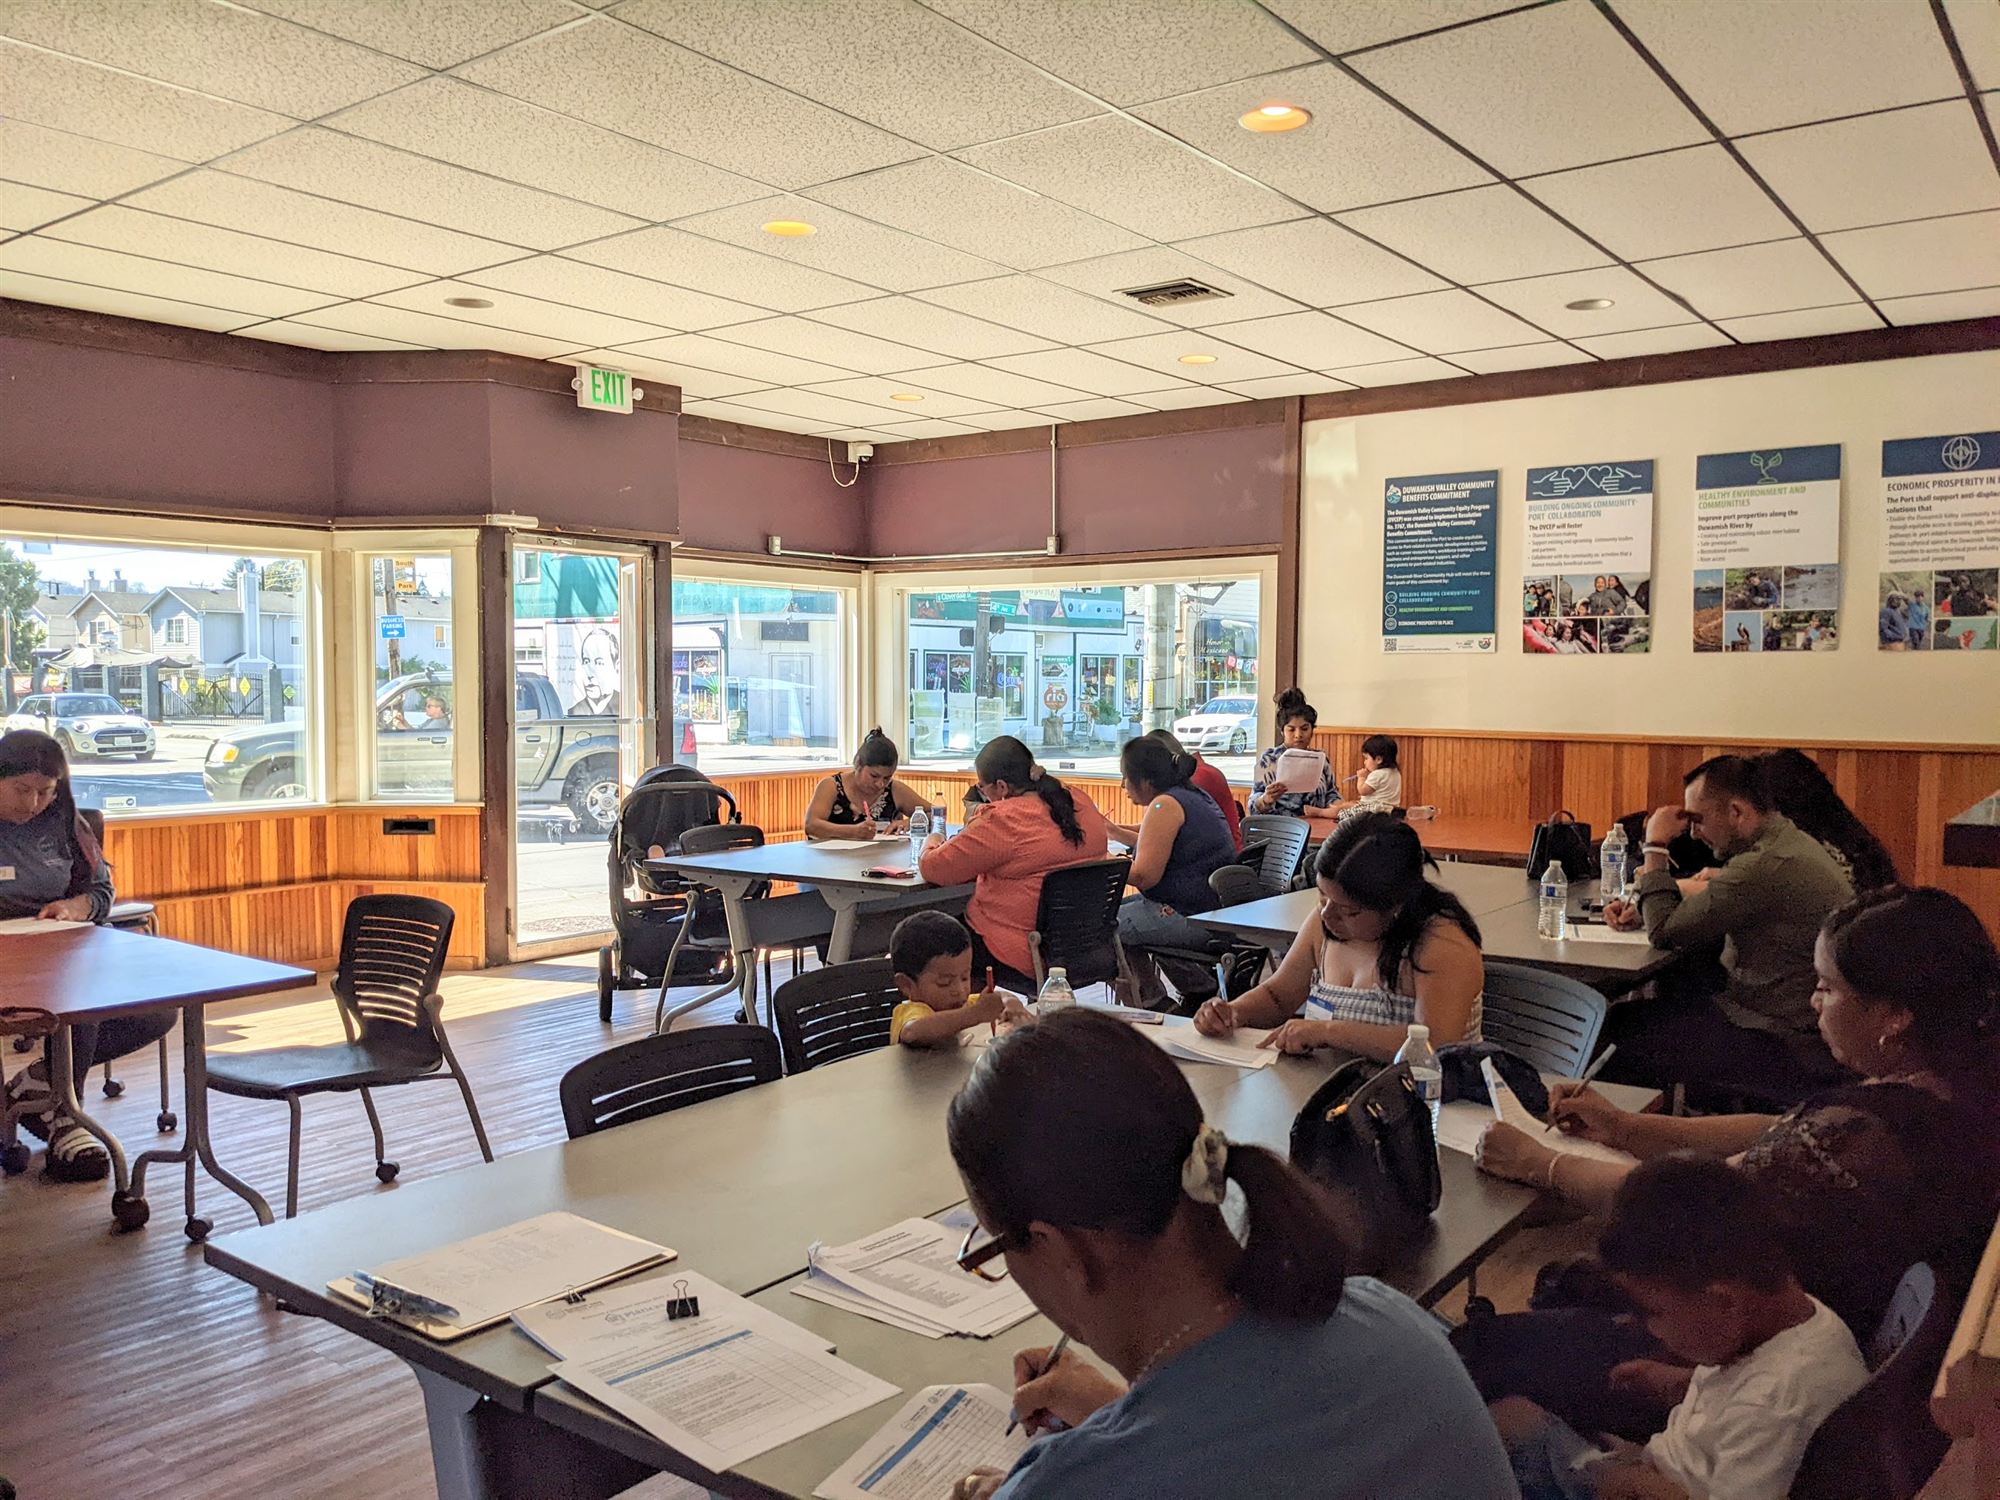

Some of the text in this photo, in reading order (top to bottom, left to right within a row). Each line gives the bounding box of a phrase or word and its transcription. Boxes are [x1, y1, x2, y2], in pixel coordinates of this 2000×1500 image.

[591, 369, 626, 407] EXIT
[1402, 480, 1495, 494] DUWAMISH VALLEY COMMUNITY
[1887, 481, 1930, 491] ECONOMIC
[1932, 477, 1984, 488] PROSPERITY
[1986, 477, 1995, 485] IN
[1402, 490, 1470, 502] BENEFITS COMMITMENT
[1698, 486, 1806, 500] HEALTHY ENVIRONMENT AND
[1933, 493, 1959, 502] support
[1528, 503, 1560, 512] BUILDING
[1561, 501, 1592, 510] ONGOING
[1698, 499, 1750, 509] COMMUNITIES
[1886, 506, 1916, 514] solutions
[1528, 510, 1601, 521] PORT COLLABORATION
[1698, 514, 1722, 523] Improve
[1723, 513, 1736, 521] port
[1736, 512, 1768, 520] properties
[1769, 510, 1786, 519] along
[1745, 522, 1753, 530] by
[1046, 689, 1065, 702] ria
